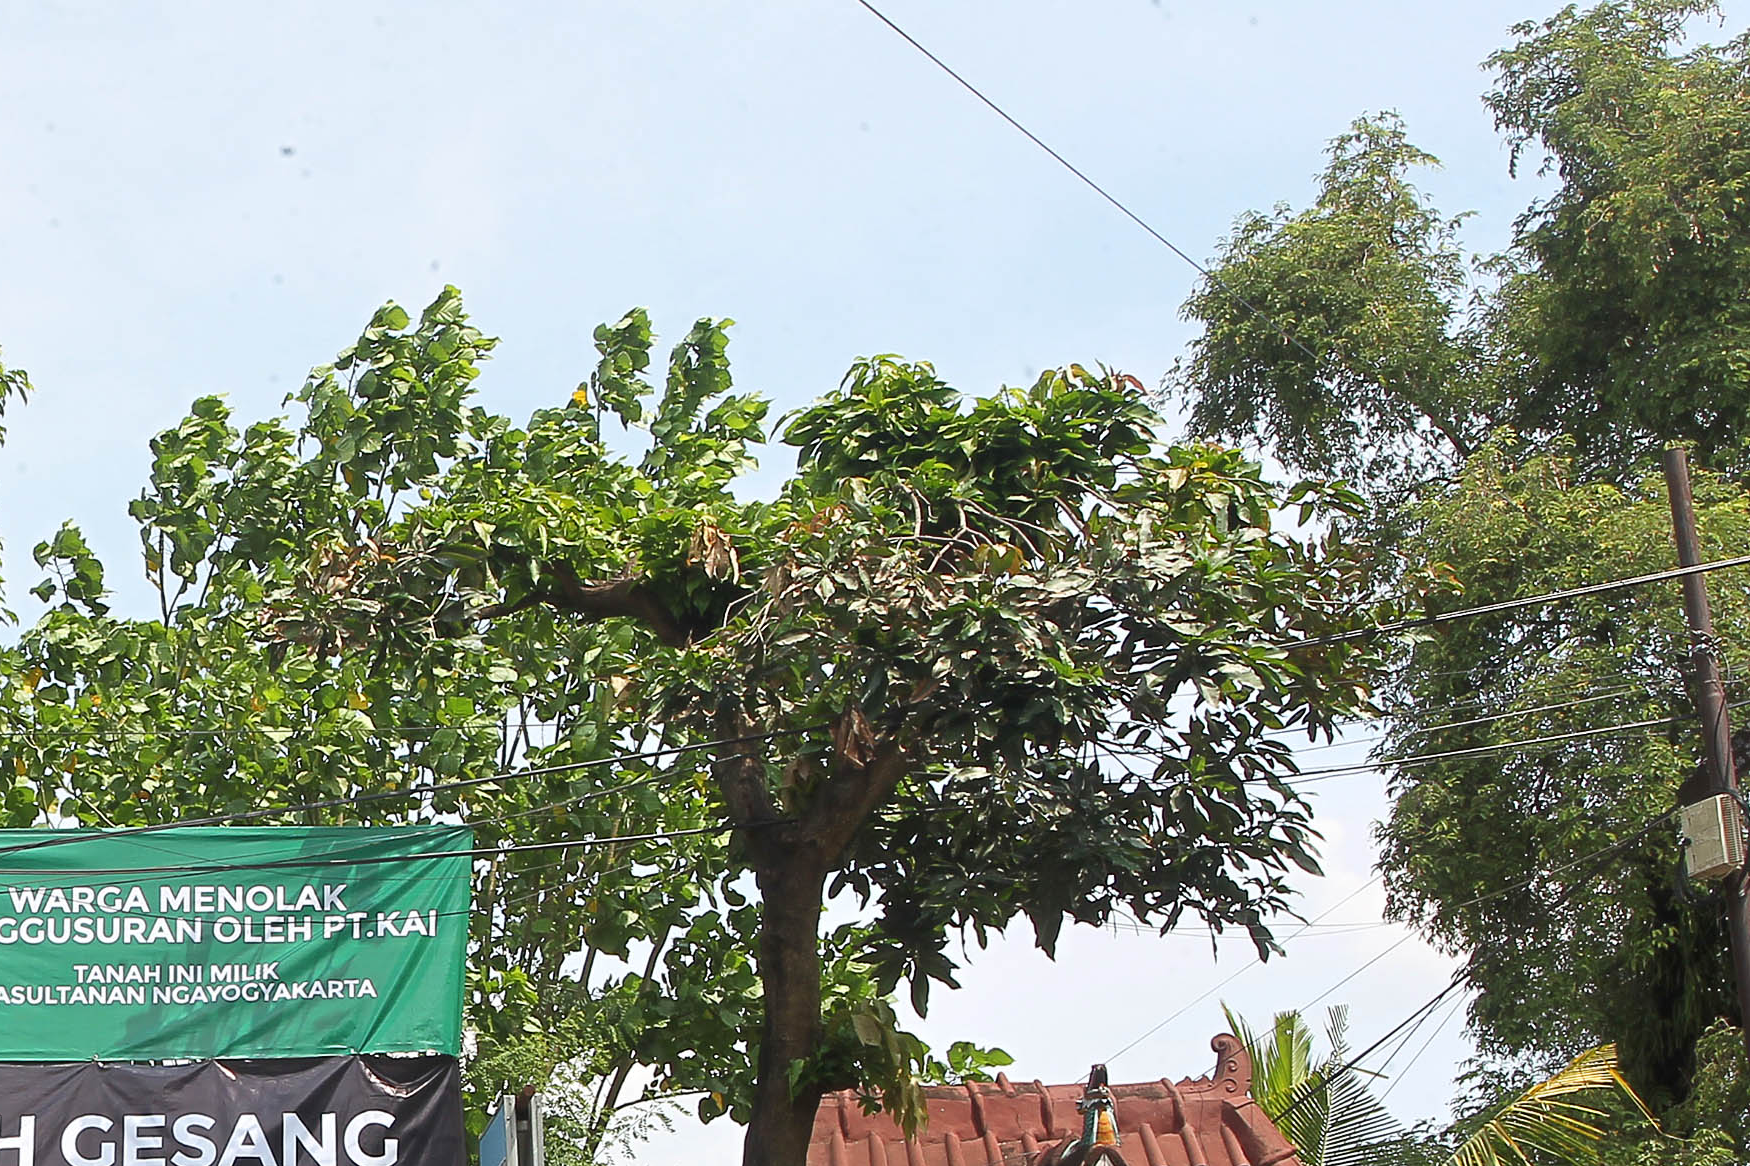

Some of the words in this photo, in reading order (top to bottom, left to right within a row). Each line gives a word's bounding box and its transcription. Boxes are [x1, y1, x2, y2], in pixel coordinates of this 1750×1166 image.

[9, 885, 153, 915] WARGA
[160, 883, 347, 913] MENOLAK
[213, 915, 314, 945] OLEH
[323, 910, 437, 940] PT.KAI
[74, 965, 160, 984] TANAH
[169, 965, 204, 984] INI
[210, 963, 279, 983] MILIK
[153, 978, 377, 1004] NGAYOGYAKARTA
